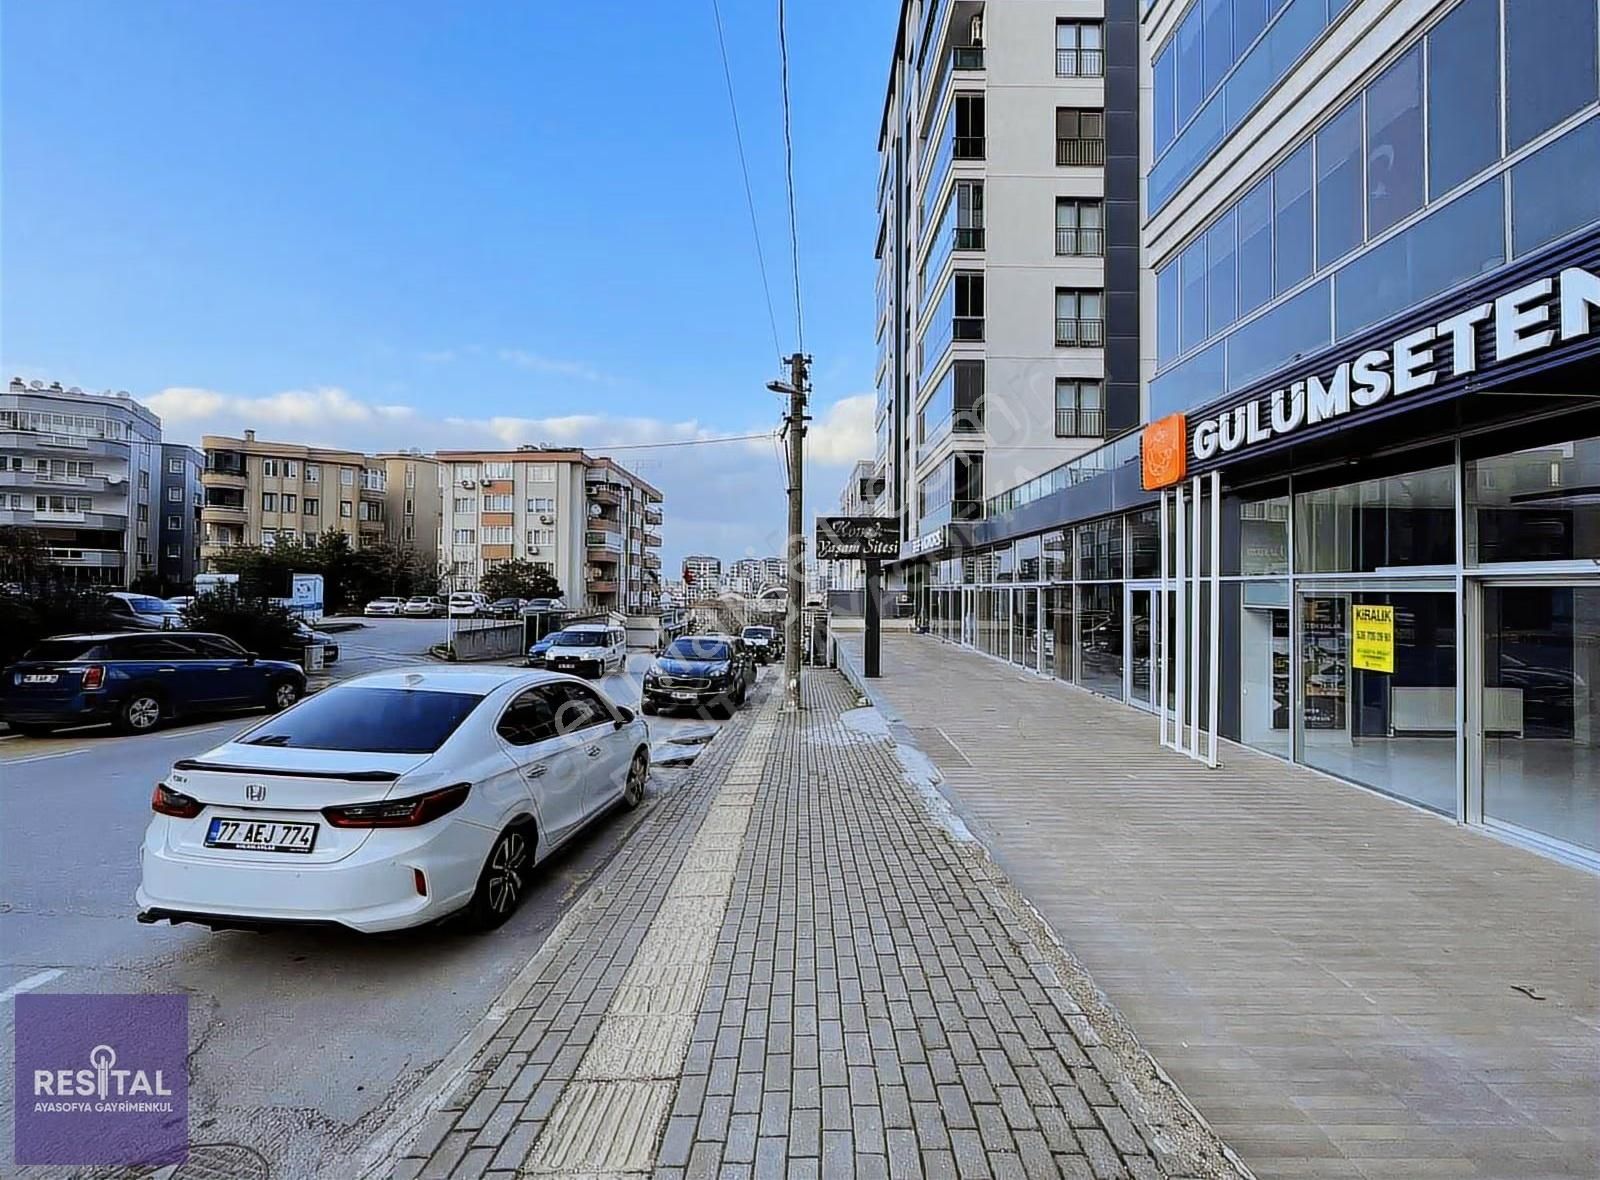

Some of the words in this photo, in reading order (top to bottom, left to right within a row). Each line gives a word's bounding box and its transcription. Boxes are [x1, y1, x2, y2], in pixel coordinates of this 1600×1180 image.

[818, 540, 860, 558] Yaşam
[863, 538, 898, 554] Sitesi
[218, 822, 240, 841] 77
[244, 823, 276, 843] AEJ
[280, 826, 311, 846] 774
